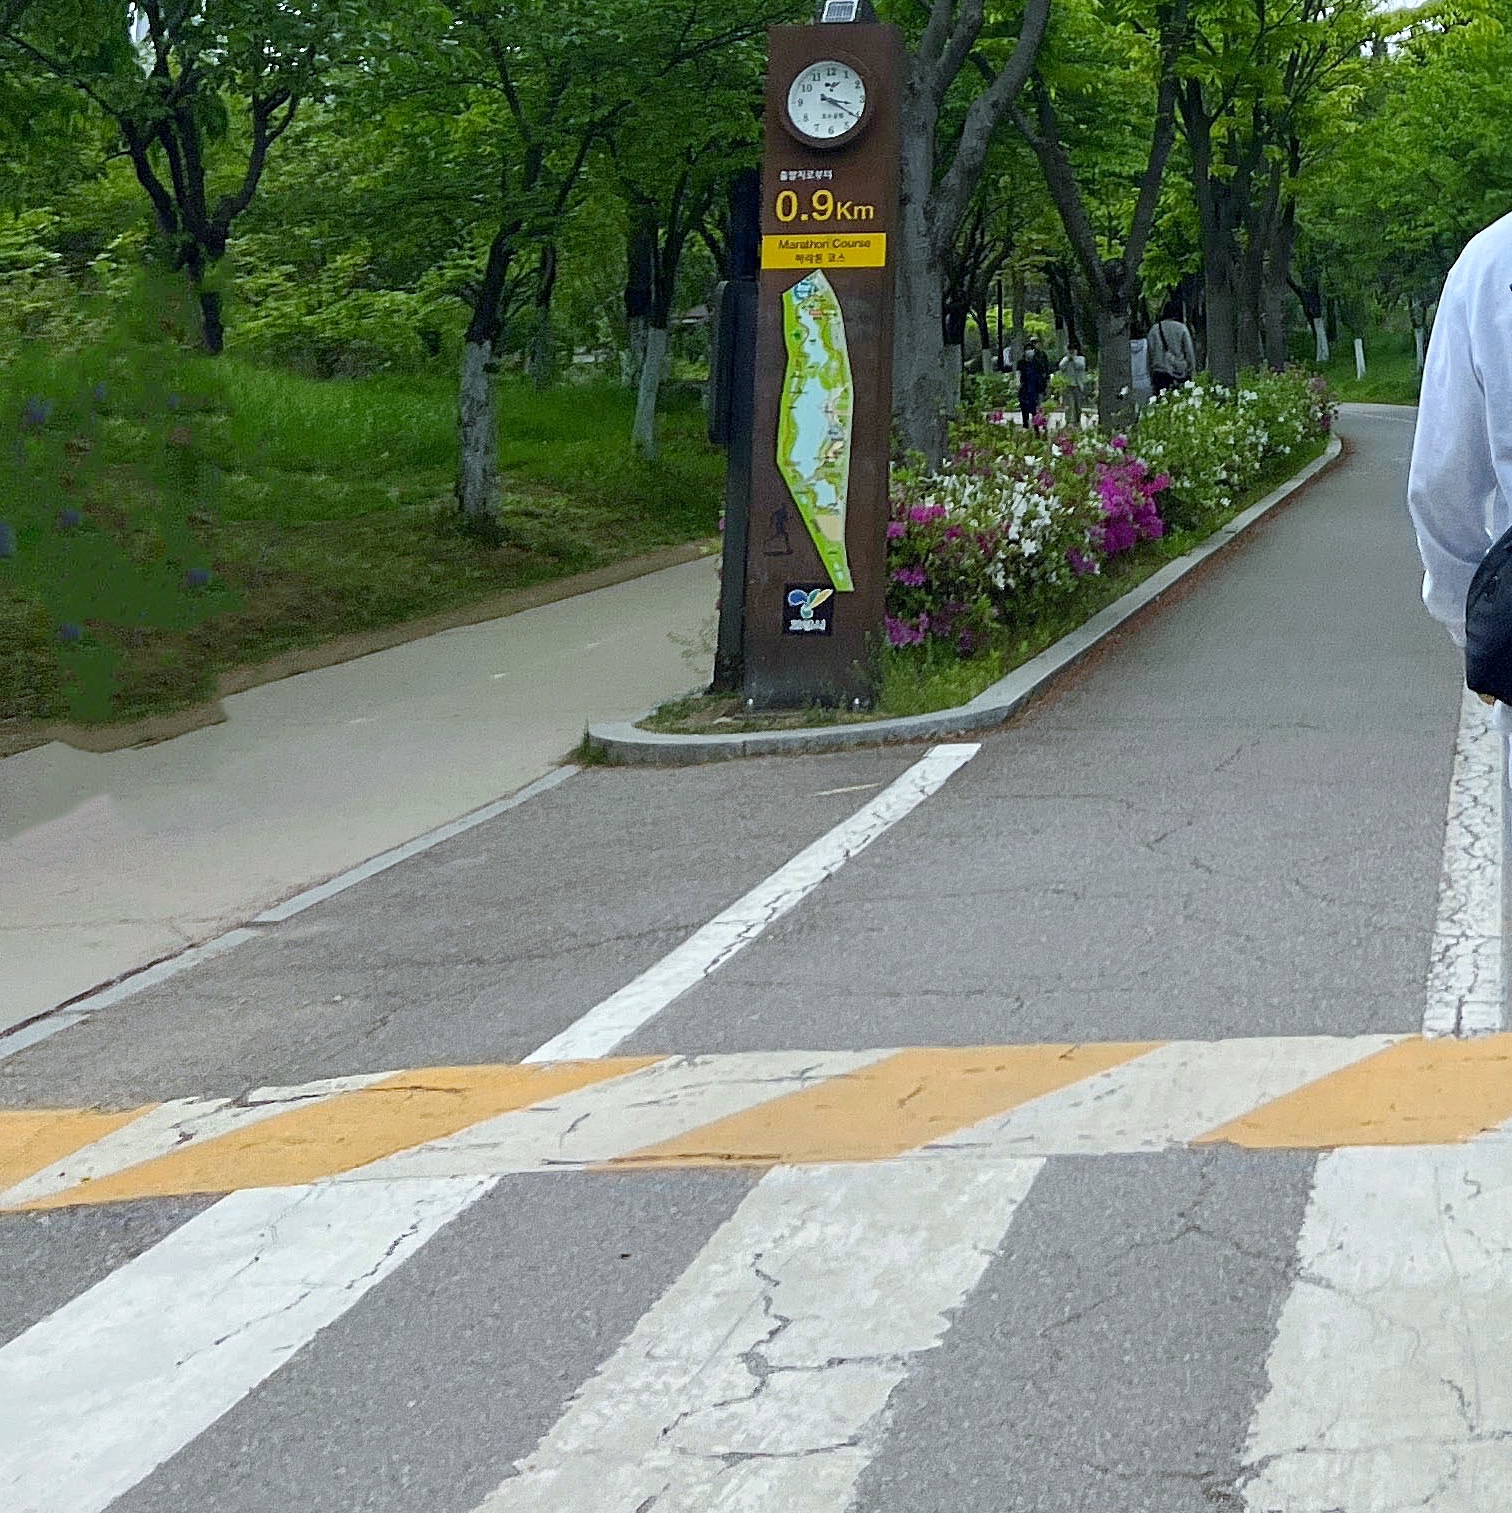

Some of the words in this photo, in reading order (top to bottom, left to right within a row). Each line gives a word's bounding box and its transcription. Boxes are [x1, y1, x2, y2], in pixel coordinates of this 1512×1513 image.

[826, 67, 837, 76] 12
[812, 73, 821, 81] 11
[802, 84, 812, 92] 10
[854, 80, 861, 89] 2
[797, 99, 804, 107] 9
[803, 113, 809, 122] 8
[828, 126, 834, 134] 6
[778, 239, 829, 249] Marathon
[832, 239, 871, 249] Course
[795, 253, 823, 264] 마라톤
[828, 254, 845, 263] 코스
